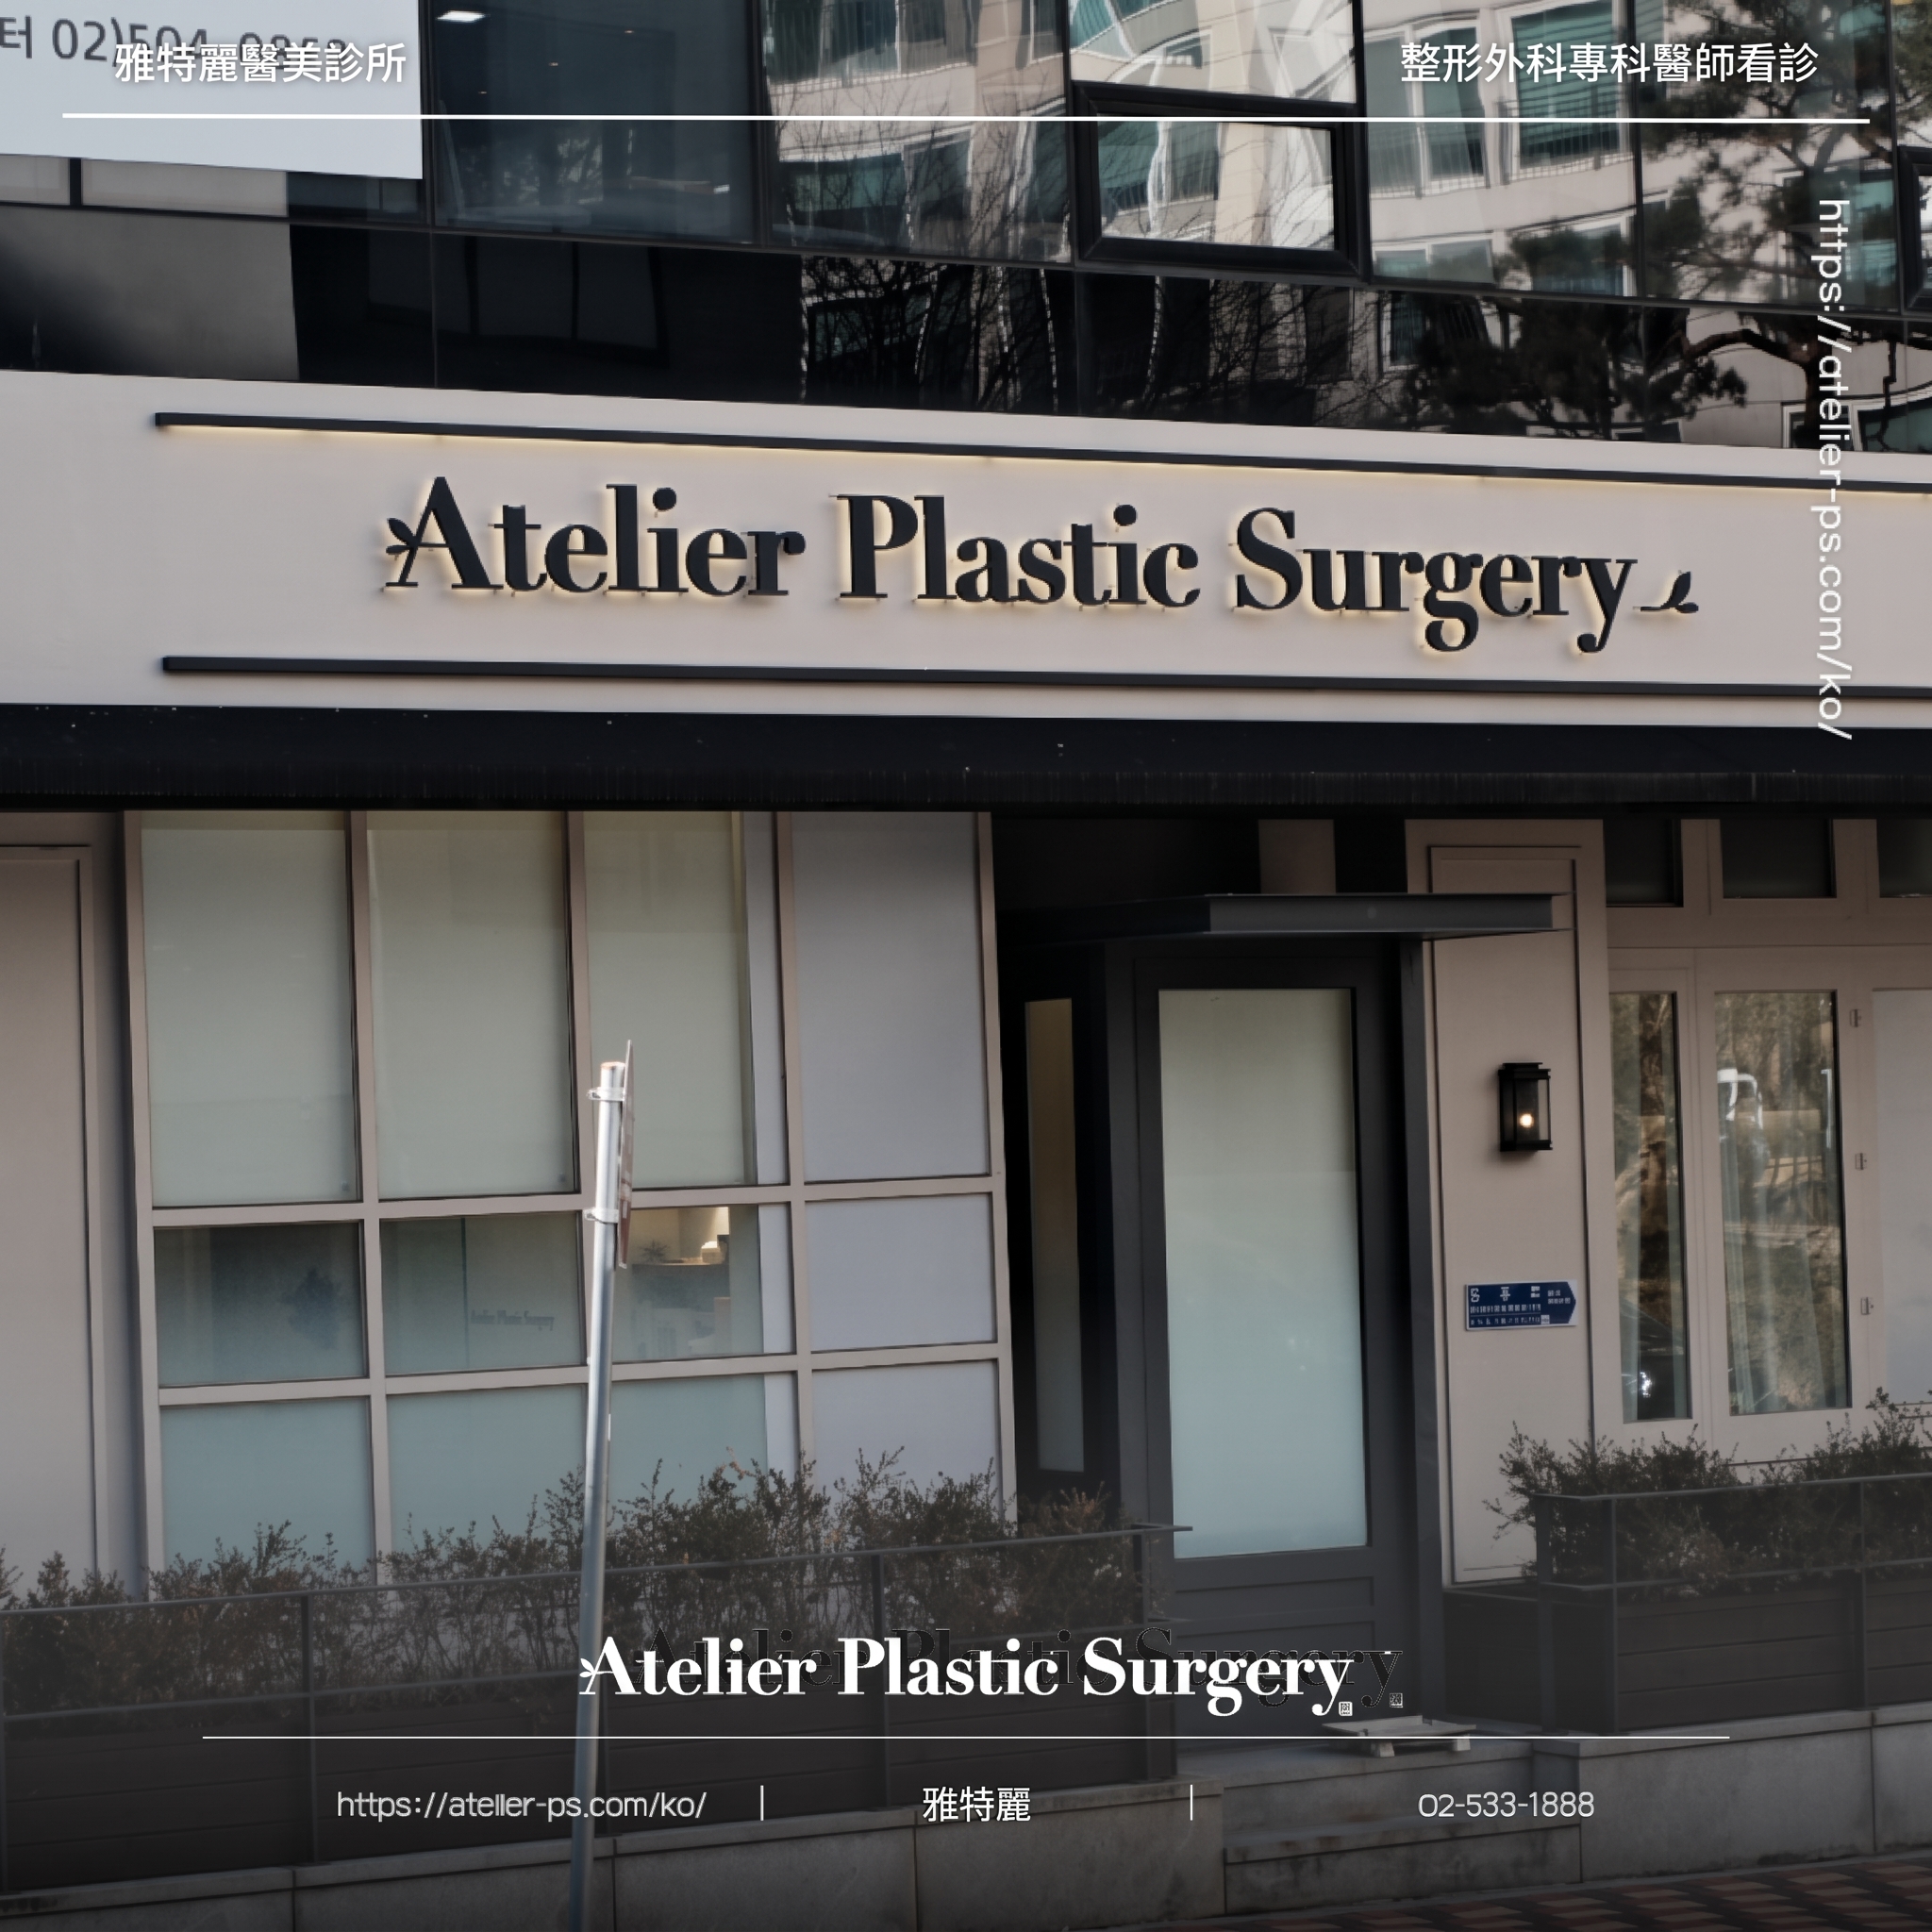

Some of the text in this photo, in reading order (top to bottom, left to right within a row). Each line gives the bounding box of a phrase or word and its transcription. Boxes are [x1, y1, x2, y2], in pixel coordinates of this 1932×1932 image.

[0, 15, 32, 58] 터
[385, 476, 1639, 654] Atelier Plastic Surgery
